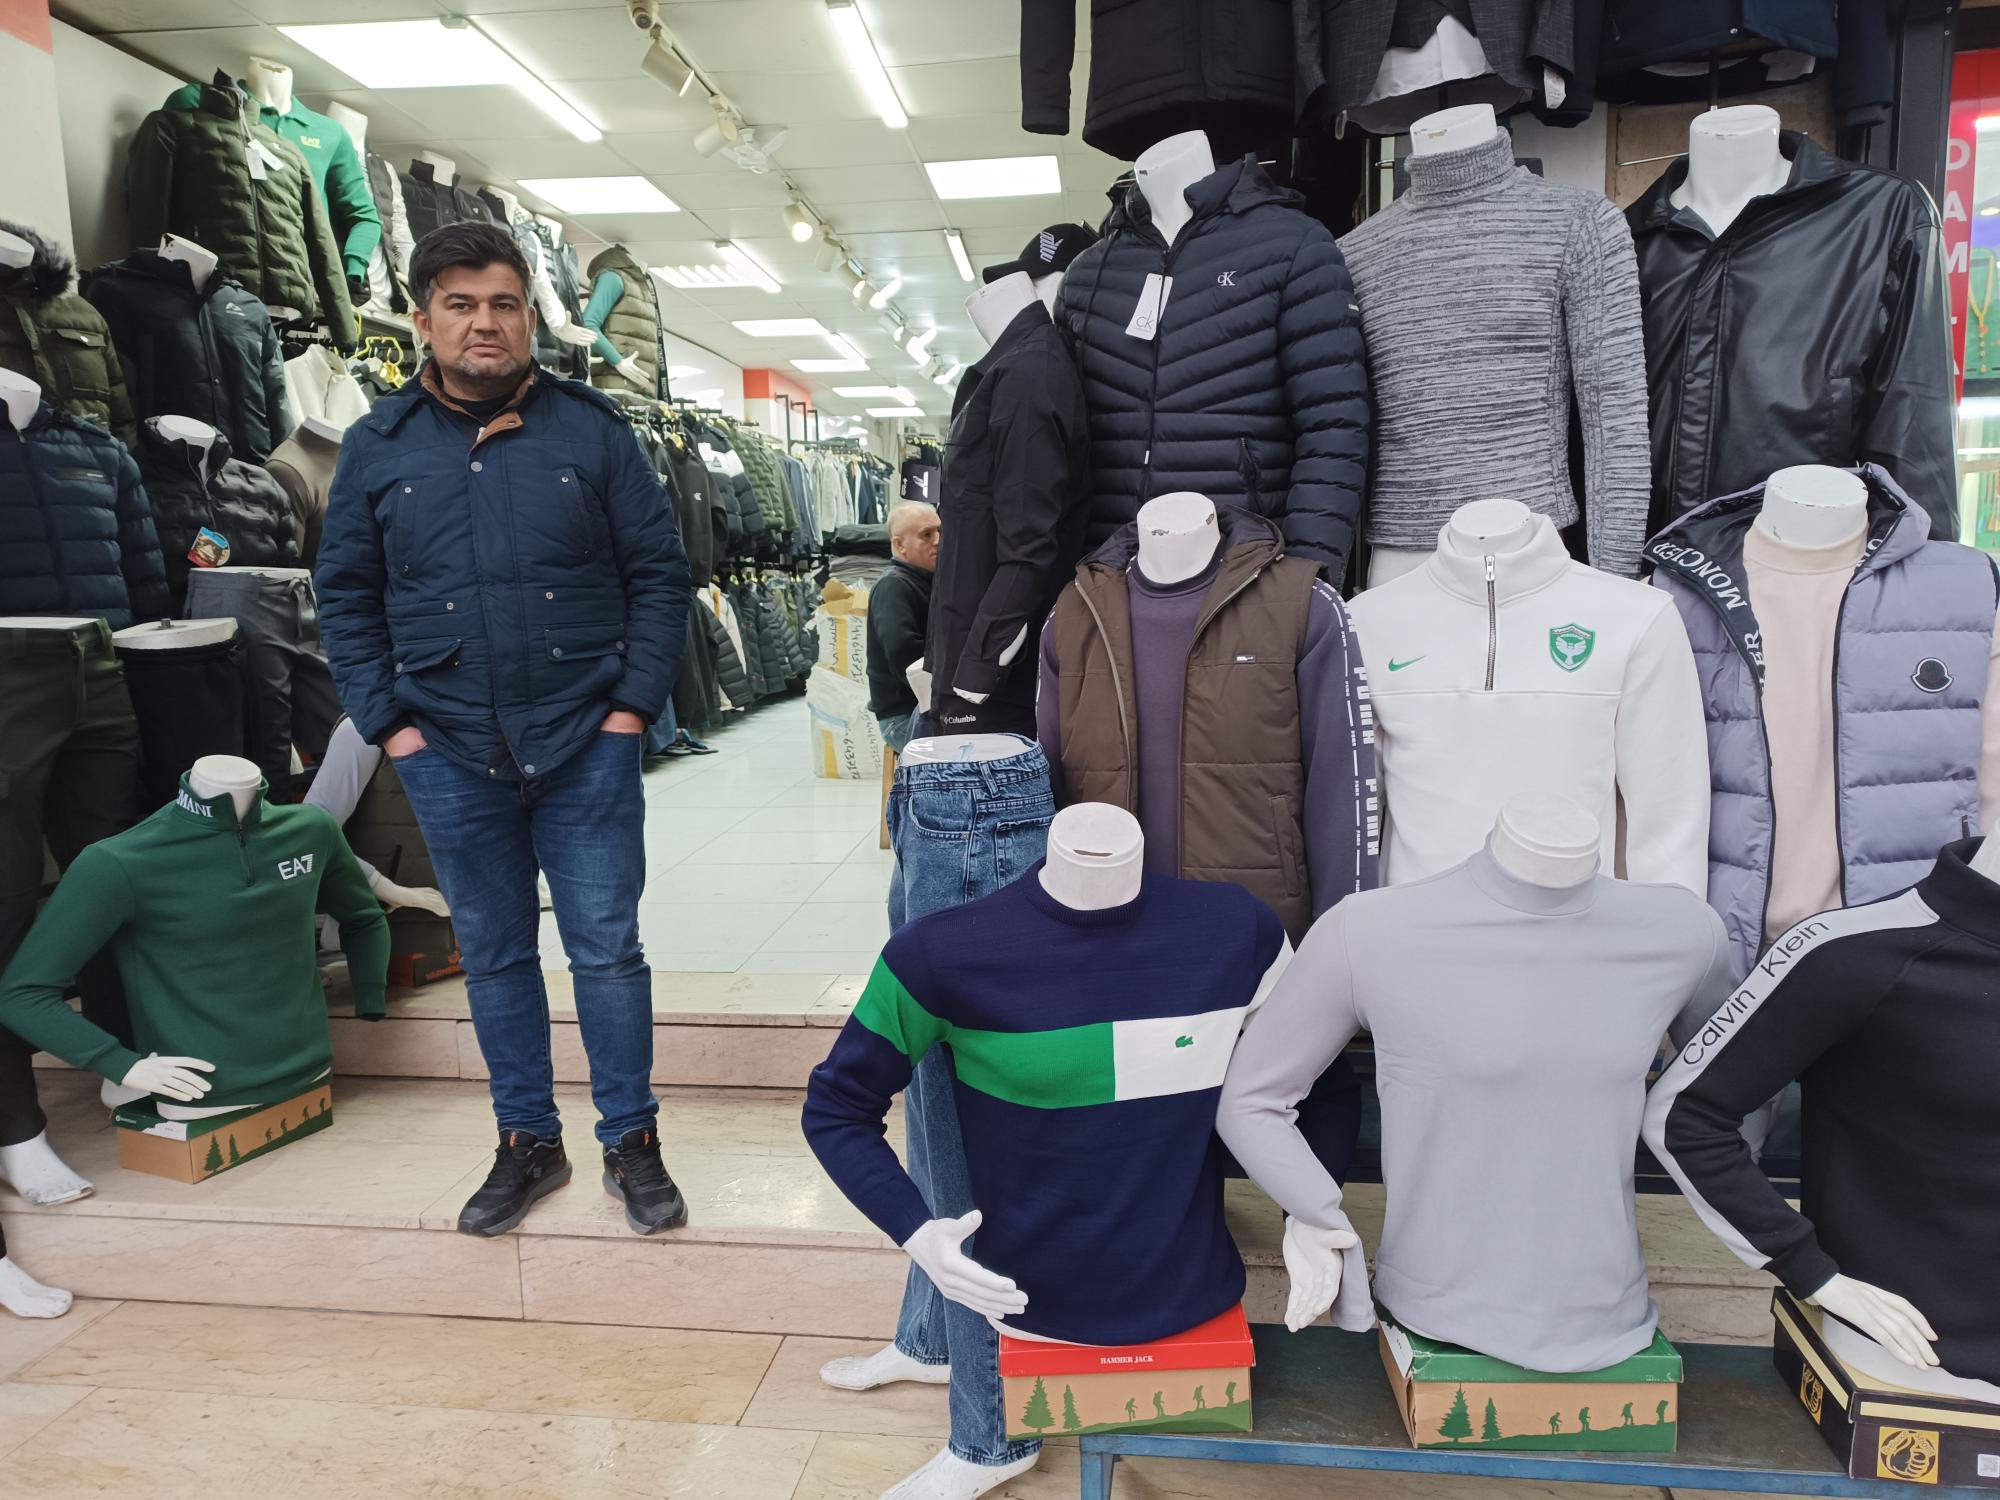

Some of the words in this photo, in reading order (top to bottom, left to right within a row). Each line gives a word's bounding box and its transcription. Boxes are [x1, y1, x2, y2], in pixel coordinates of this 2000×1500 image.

[949, 714, 977, 724] Columbia
[176, 788, 214, 818] MANI
[278, 853, 313, 880] EA7
[1683, 989, 1757, 1065] Calvin
[1760, 921, 1829, 978] Klein
[1100, 1356, 1133, 1364] HAMMER
[1134, 1355, 1154, 1363] JACK
